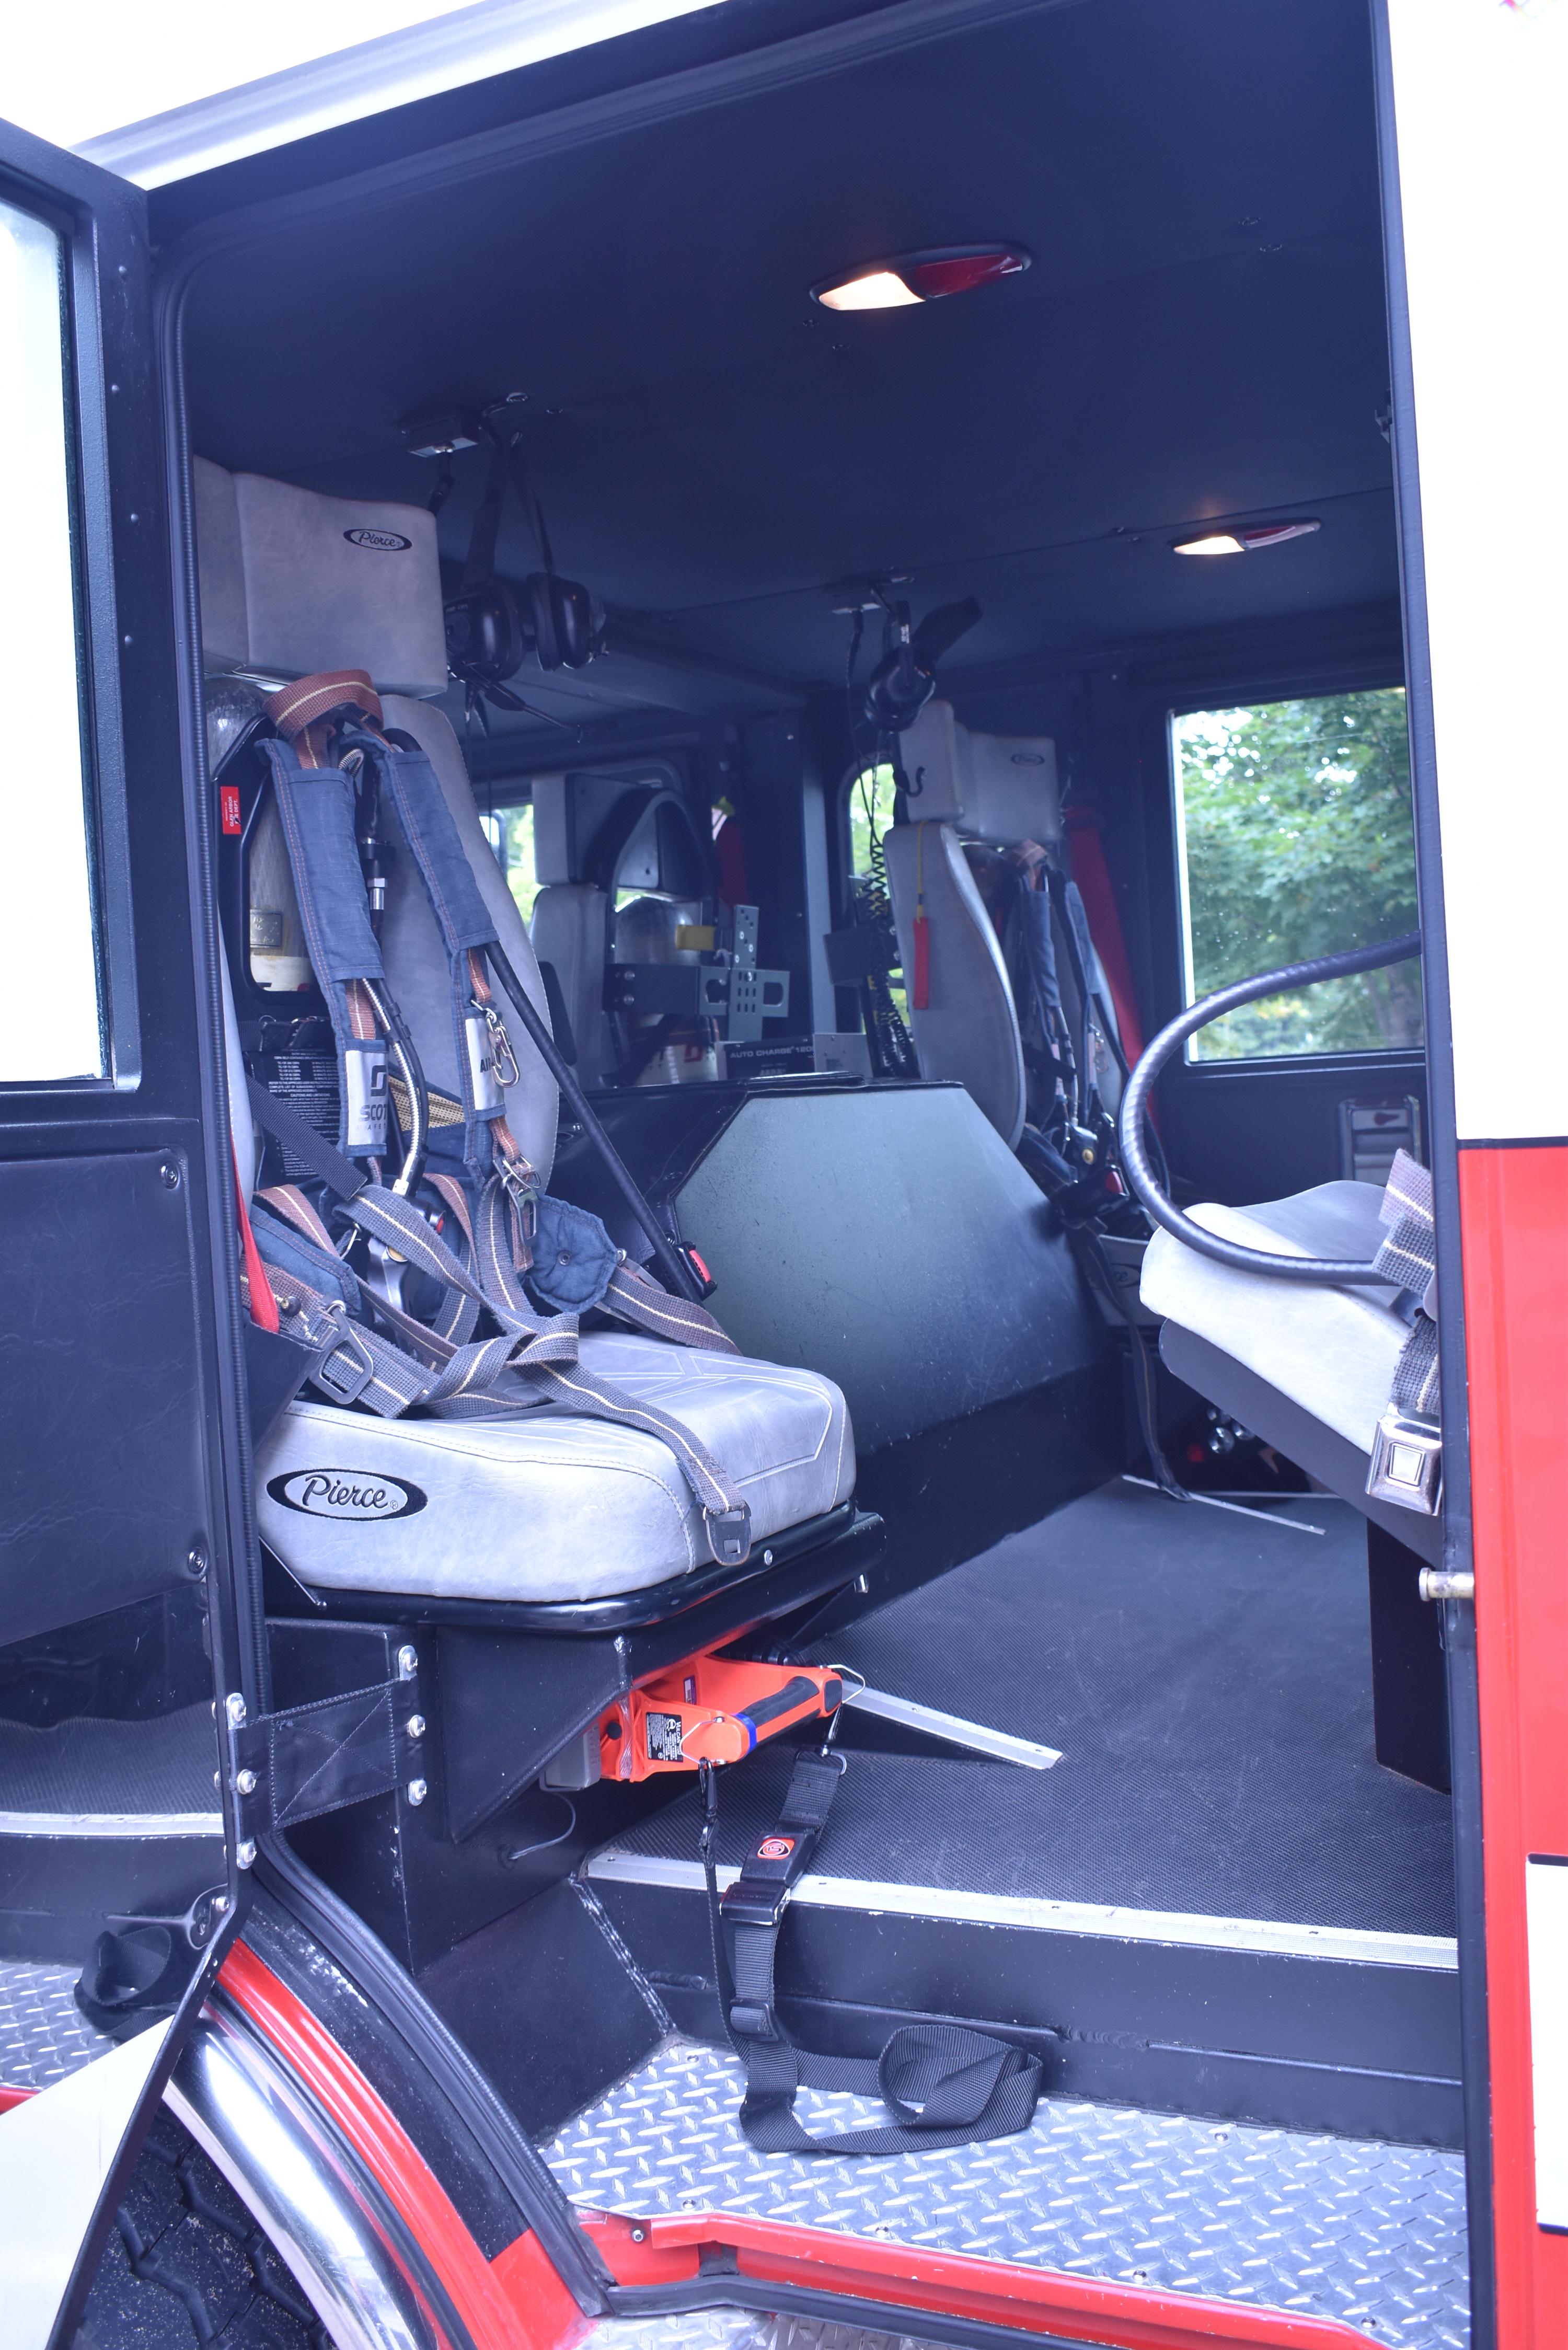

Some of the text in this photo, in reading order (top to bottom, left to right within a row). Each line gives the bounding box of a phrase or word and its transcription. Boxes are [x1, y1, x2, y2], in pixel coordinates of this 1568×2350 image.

[359, 531, 396, 547] Pierce
[730, 1045, 814, 1058] AUTO CHARGE 120
[359, 1104, 388, 1122] SCOT
[302, 1474, 388, 1509] Pierce
